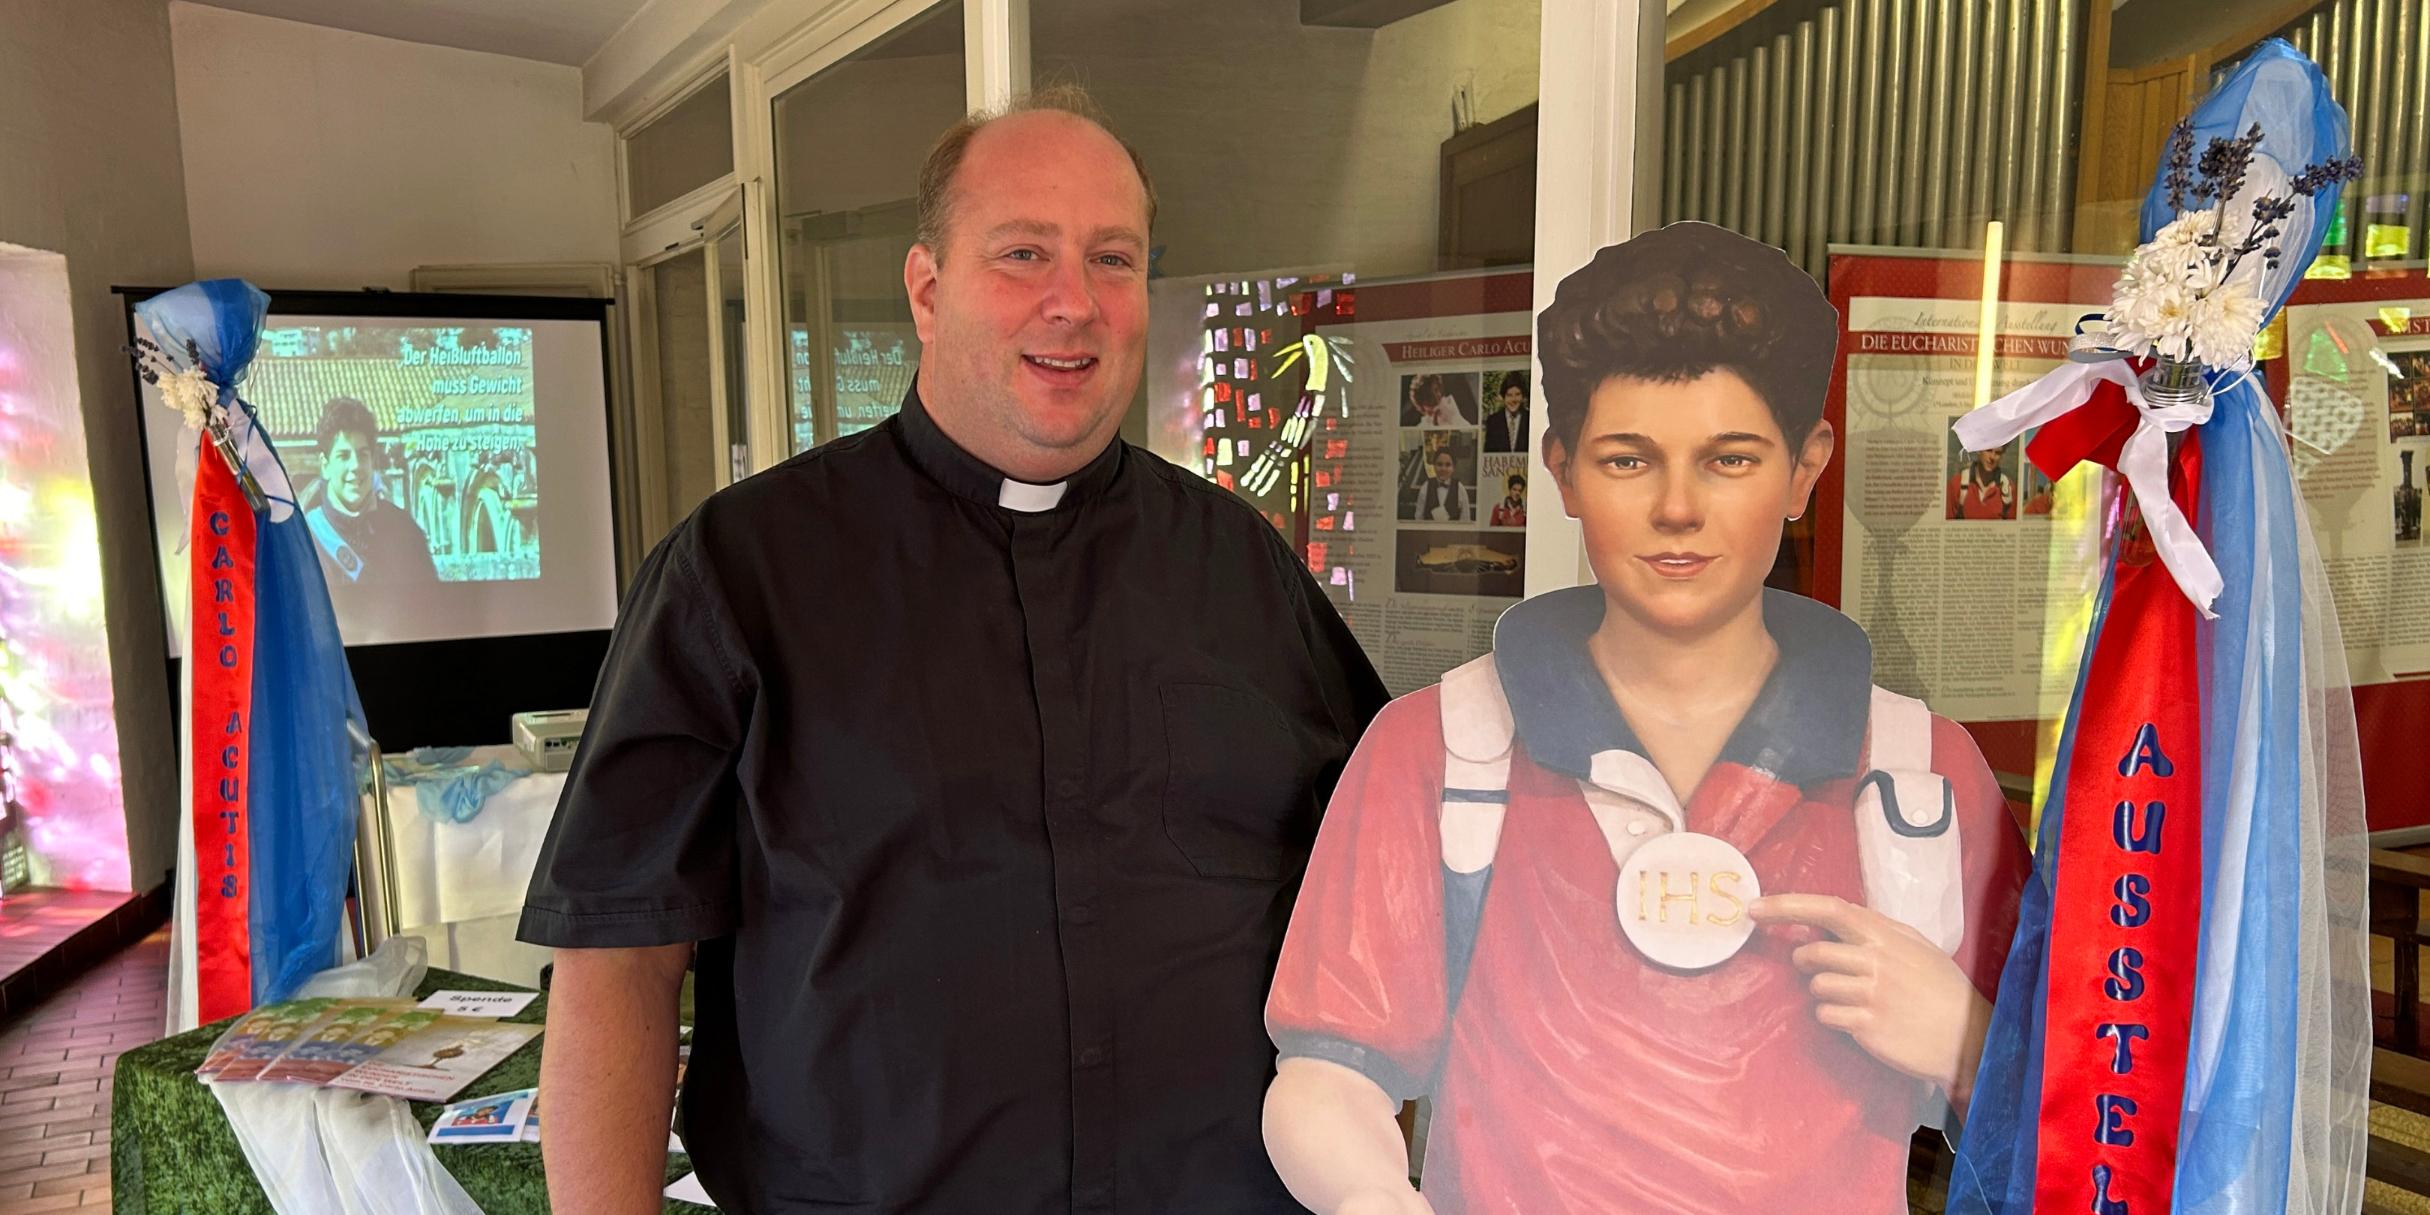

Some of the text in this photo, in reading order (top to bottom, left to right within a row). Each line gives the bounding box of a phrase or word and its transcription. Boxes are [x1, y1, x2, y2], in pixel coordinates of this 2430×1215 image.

[1458, 341, 1500, 356] CARLO
[1503, 339, 1530, 354] ACU
[1861, 333, 1888, 350] DIE
[1891, 334, 2034, 353] EUCHARISTCHEN
[402, 346, 521, 366] Der Heißluftballon
[432, 375, 523, 394] muss Gewicht
[396, 404, 522, 424] abwerfen, um in die
[416, 433, 449, 451] Höhe
[451, 437, 467, 451] zu
[209, 511, 238, 668] CARLO
[219, 711, 243, 898] ACUTIS
[1637, 870, 1743, 928] IHS
[2090, 722, 2175, 1215] AUSSTEL
[449, 994, 513, 1004] Spende
